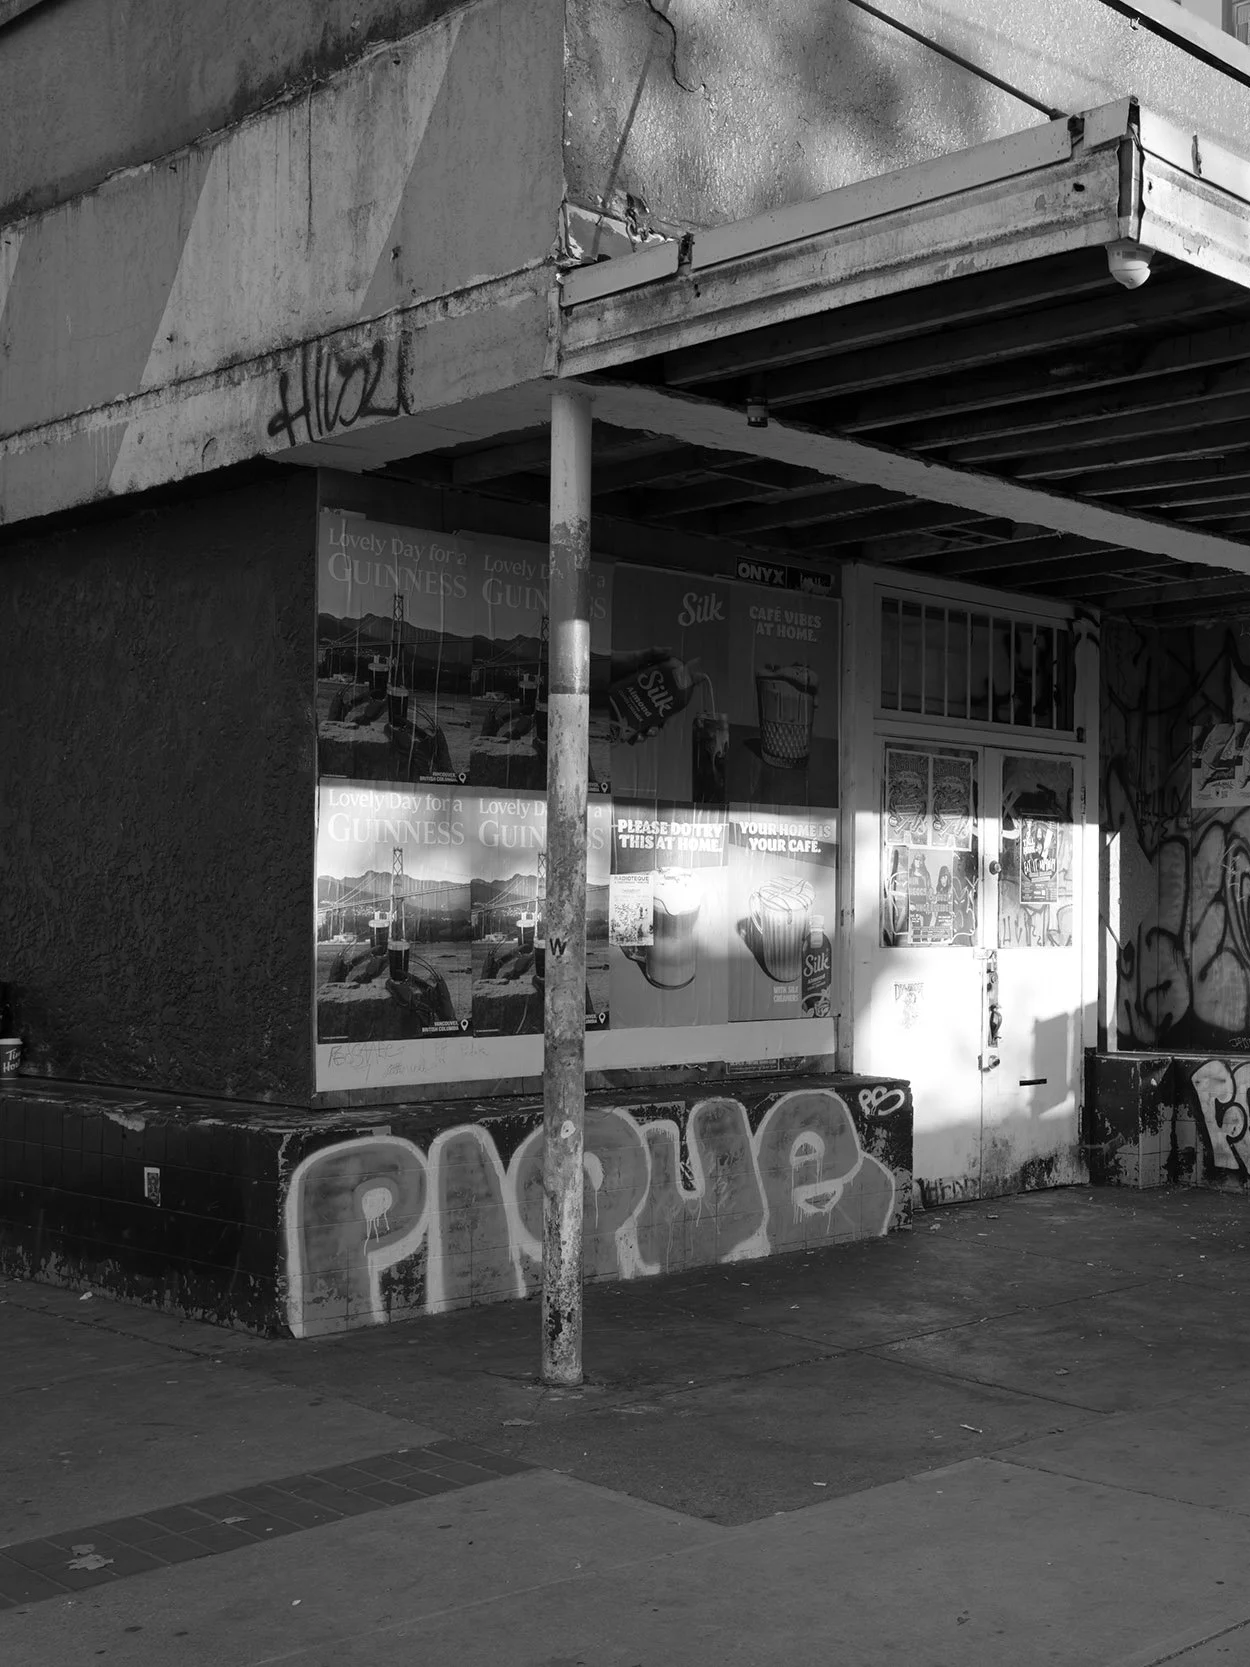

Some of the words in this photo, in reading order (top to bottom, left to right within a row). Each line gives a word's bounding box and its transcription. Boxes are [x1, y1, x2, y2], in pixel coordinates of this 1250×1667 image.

[328, 528, 387, 556] Lovely
[391, 538, 427, 564] Day
[429, 543, 452, 562] for
[457, 553, 467, 565] a
[327, 552, 468, 600] GUINNESS
[484, 555, 540, 581] Lovely
[738, 562, 784, 586] ONYX
[678, 592, 726, 627] Silk
[750, 606, 782, 622] CAFÉ
[784, 610, 823, 629] VIBES
[755, 622, 774, 636] AT
[776, 625, 818, 643] HOME.
[637, 670, 674, 718] Silk
[328, 789, 382, 810] Lovely
[391, 792, 421, 814] Day
[453, 799, 463, 813] a
[479, 798, 531, 819] Lovely
[327, 812, 465, 846] GUINNESS
[617, 818, 668, 835] PLEASE
[671, 822, 692, 835] DO
[692, 823, 724, 838] TRY
[739, 821, 777, 836] YOUR
[780, 823, 815, 837] HOME
[817, 825, 831, 838] IS
[618, 834, 655, 849] THIS
[656, 835, 674, 850] AT
[677, 836, 723, 852] HOME.
[748, 838, 786, 852] YOUR
[788, 837, 821, 853] CAFÉ.
[550, 938, 568, 956] W
[803, 953, 830, 977] Silk
